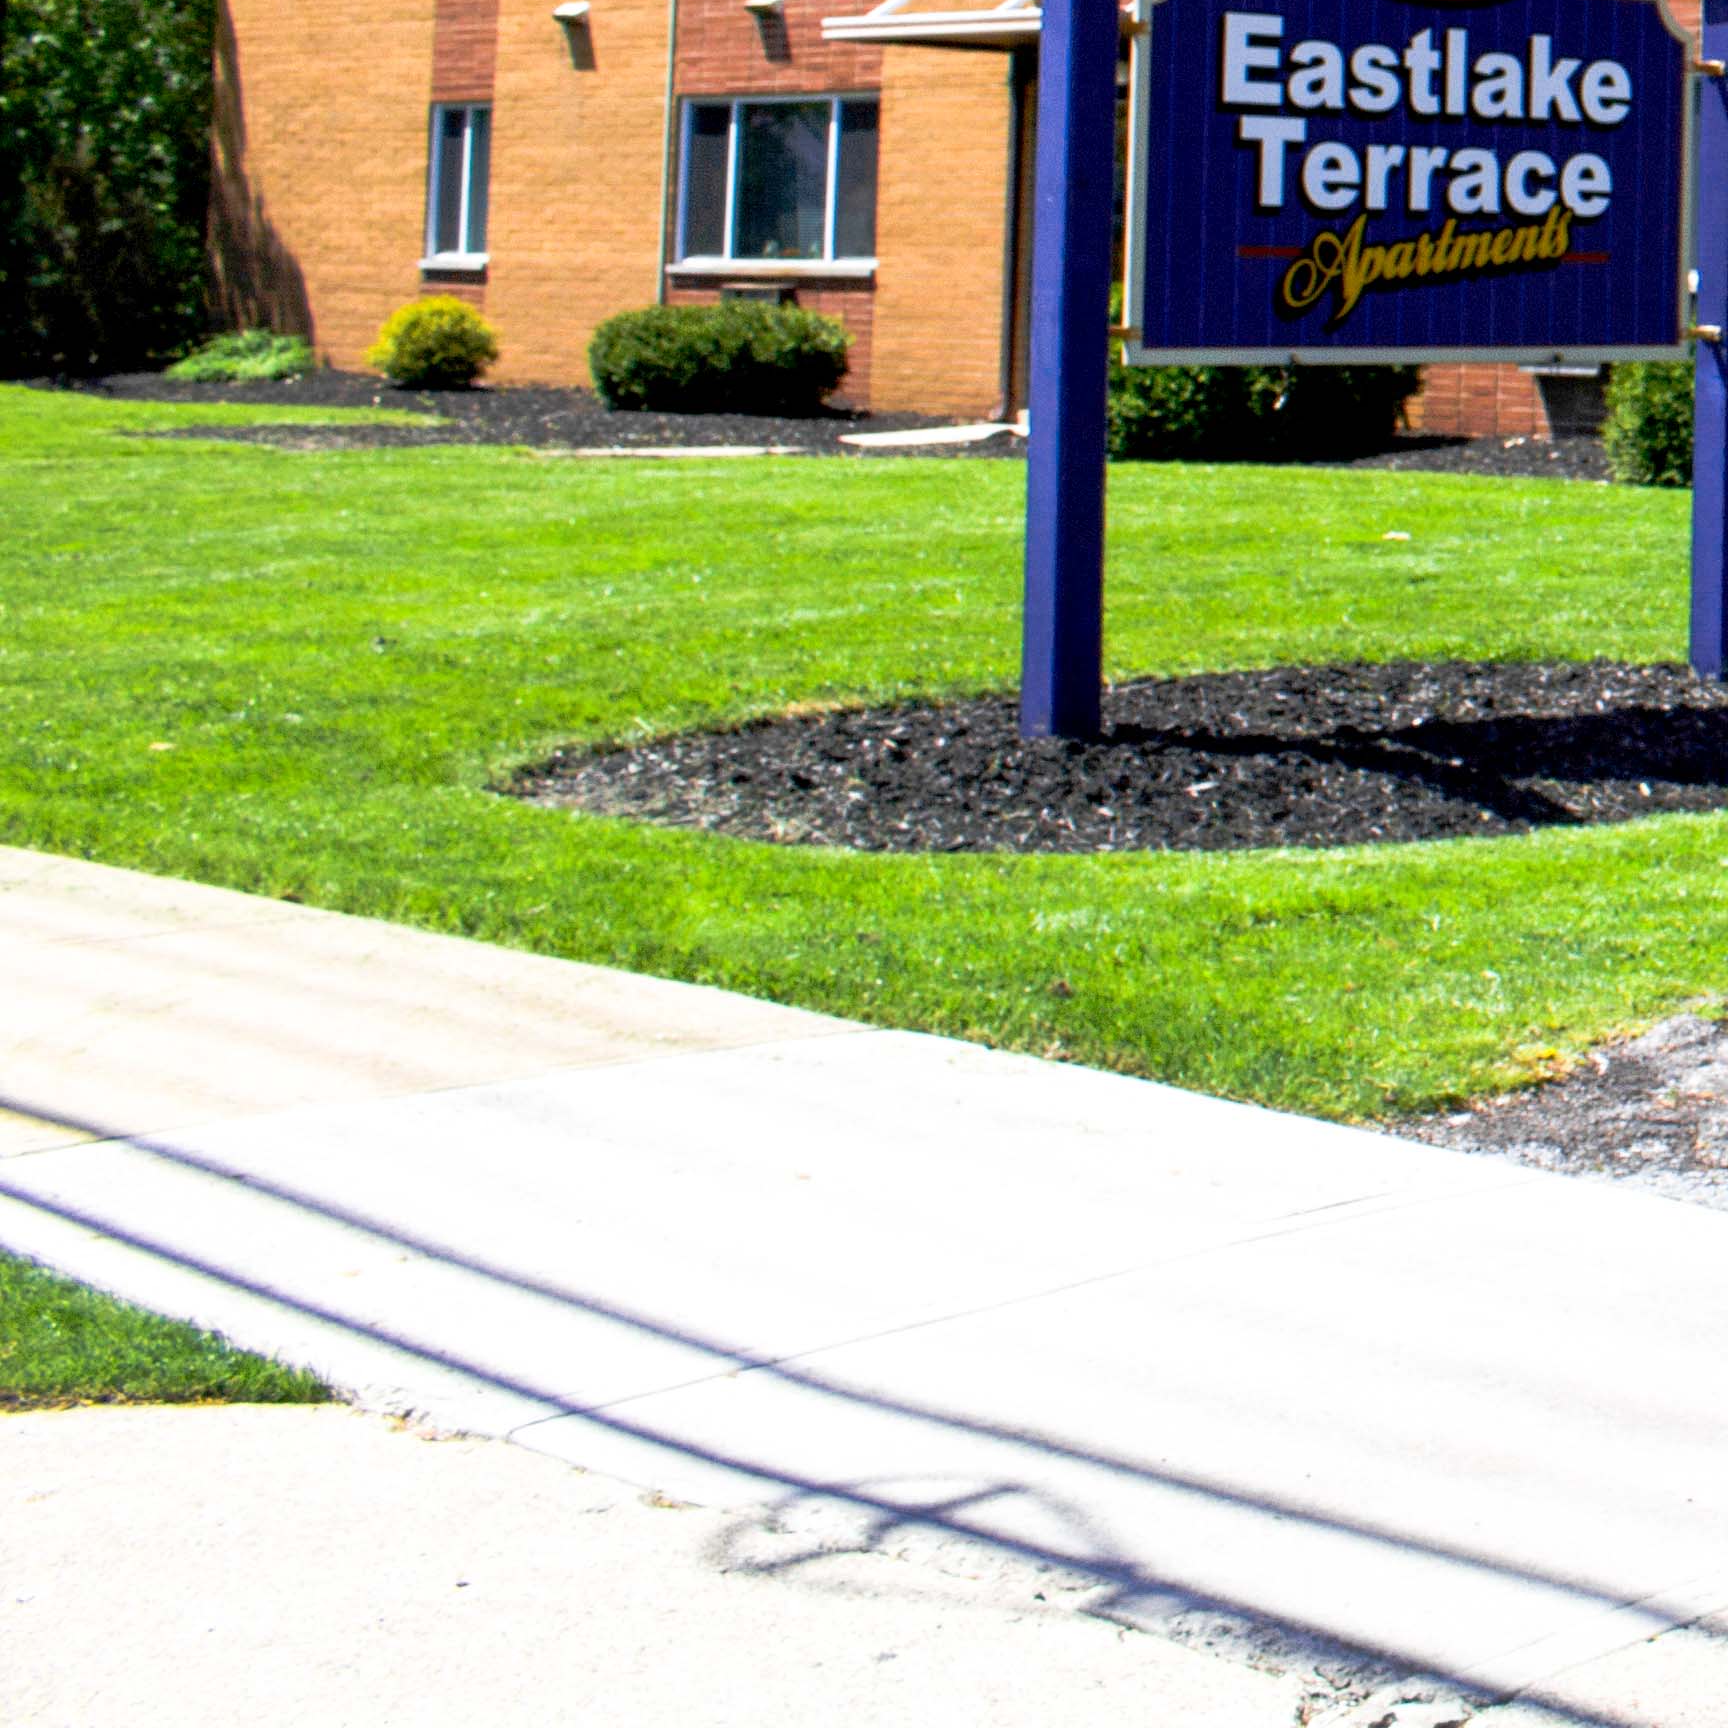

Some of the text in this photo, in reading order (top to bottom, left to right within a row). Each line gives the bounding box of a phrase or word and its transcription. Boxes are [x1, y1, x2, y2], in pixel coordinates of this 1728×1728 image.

[1221, 11, 1632, 125] Eastlake
[1239, 114, 1613, 218] Terrace
[1282, 205, 1573, 321] Apartments
